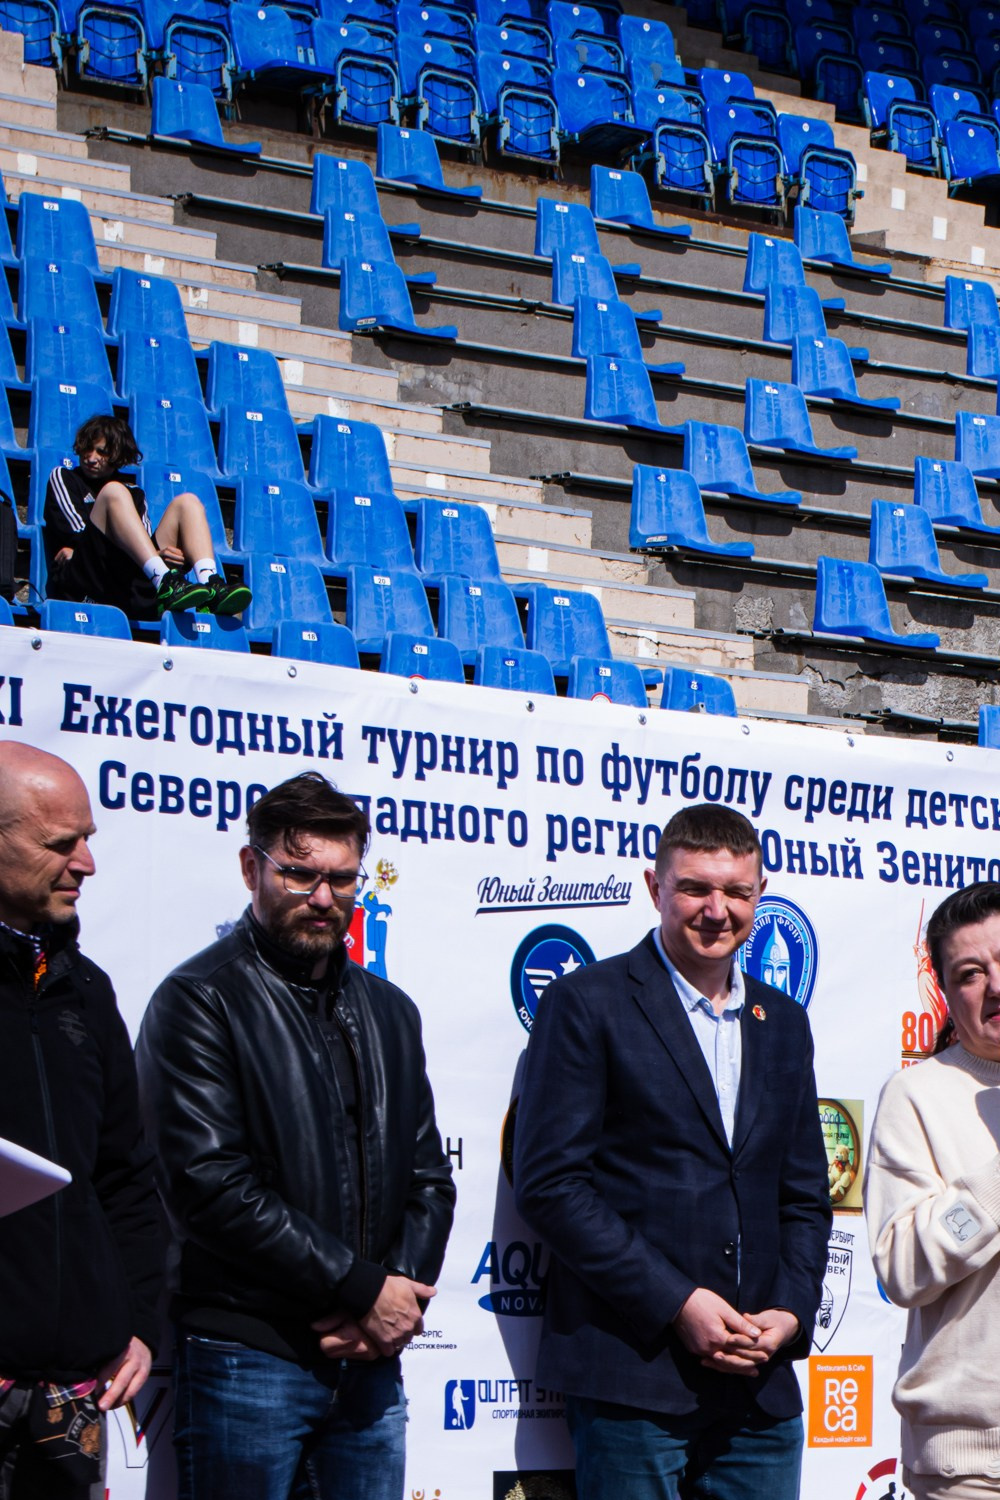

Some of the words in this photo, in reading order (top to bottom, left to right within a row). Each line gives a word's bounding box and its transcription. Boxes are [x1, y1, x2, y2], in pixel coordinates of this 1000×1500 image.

[60, 682, 344, 760] Ежегодный
[361, 725, 519, 790] турнир
[535, 745, 584, 787] по
[601, 742, 773, 818] футболу
[783, 774, 894, 824] среди
[545, 813, 662, 862] регио
[476, 876, 535, 904] Юный
[537, 874, 632, 902] Зенитовец
[776, 917, 803, 944] ФРОНТ
[901, 1011, 934, 1053] 80
[471, 1241, 552, 1290] AQU
[827, 1266, 846, 1276] ВЕК
[828, 1252, 850, 1267] НЫЙ
[421, 1330, 443, 1338] ФРПС
[853, 1364, 866, 1372] Cafe
[478, 1379, 533, 1403] OUTFIT
[825, 1377, 859, 1405] Re
[492, 1409, 534, 1419] СПОРТИВНАЯ
